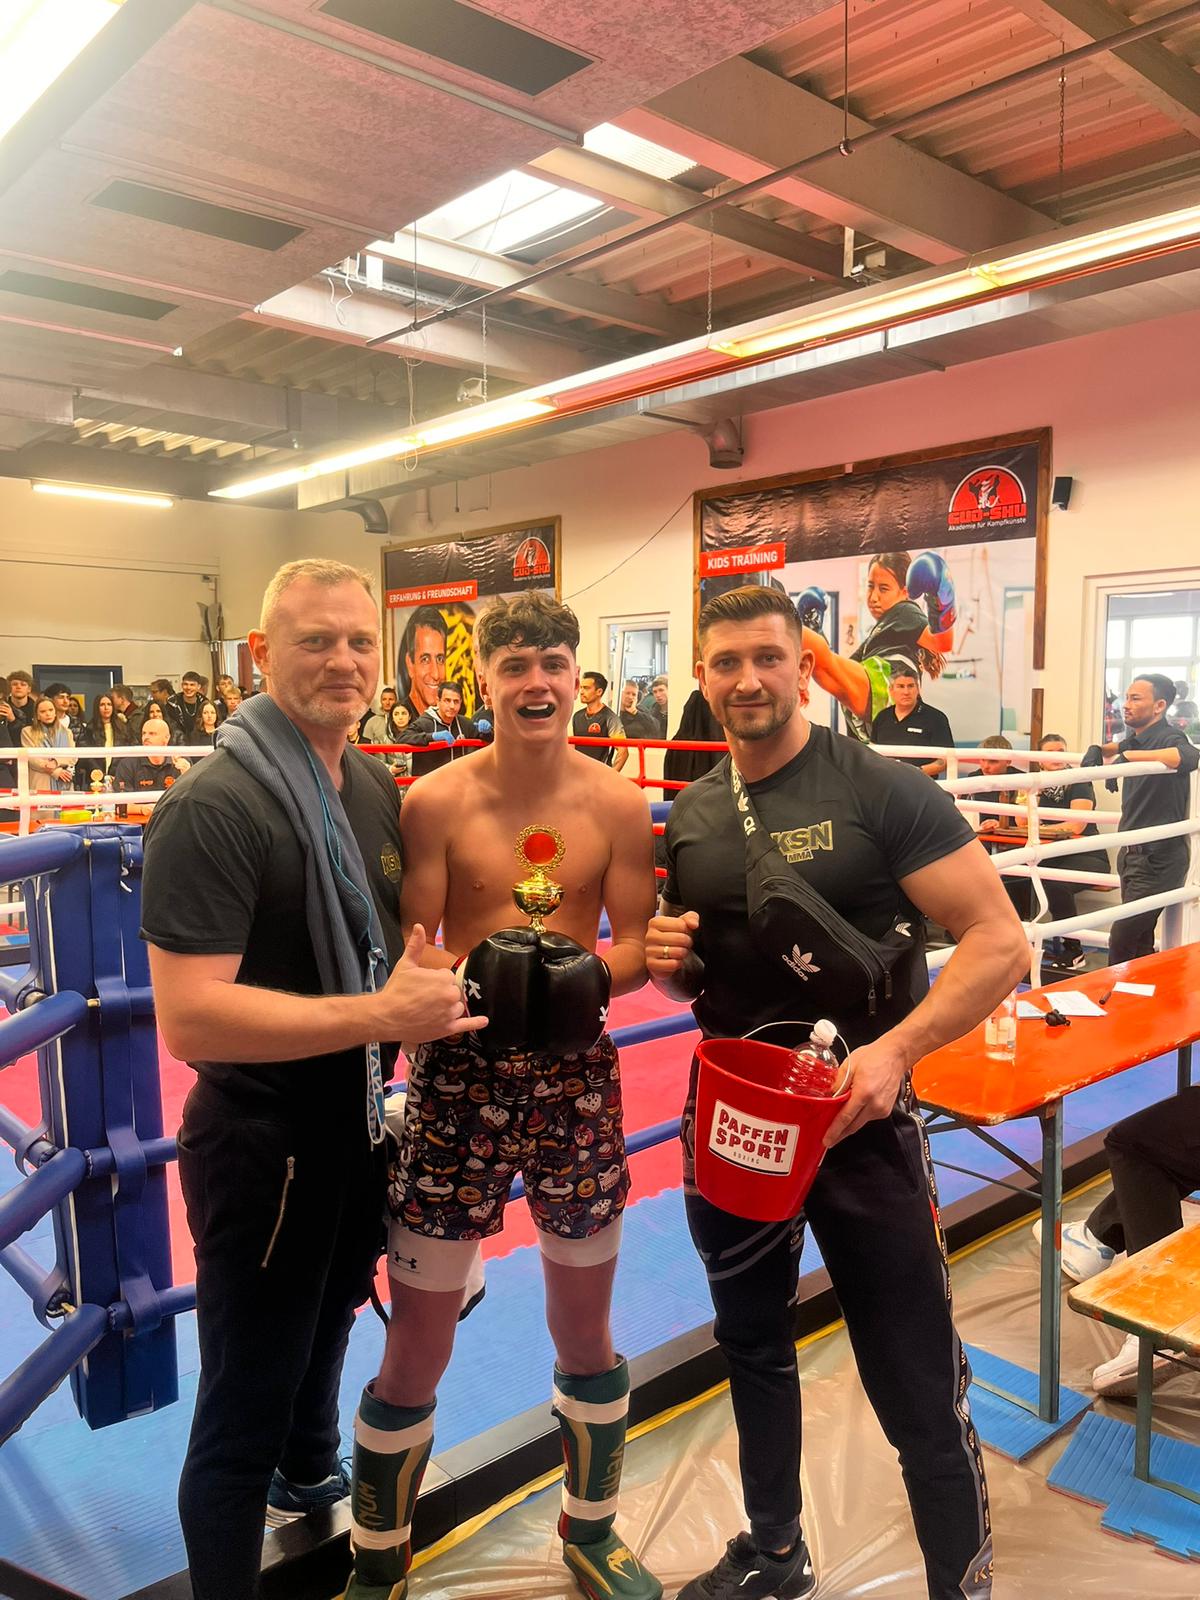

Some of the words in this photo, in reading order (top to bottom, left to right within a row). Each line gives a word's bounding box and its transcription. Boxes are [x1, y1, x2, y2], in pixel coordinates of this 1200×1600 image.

[948, 503, 1027, 525] GUO-SHU
[707, 557, 730, 570] KIDS
[731, 551, 778, 567] TRAINING
[389, 592, 421, 603] ERFAHRUNG
[427, 586, 473, 599] FREUNDSCHAFT
[770, 820, 833, 856] KSN
[787, 850, 814, 863] MMA
[781, 954, 809, 981] adidas
[718, 1108, 789, 1145] PAFFEN
